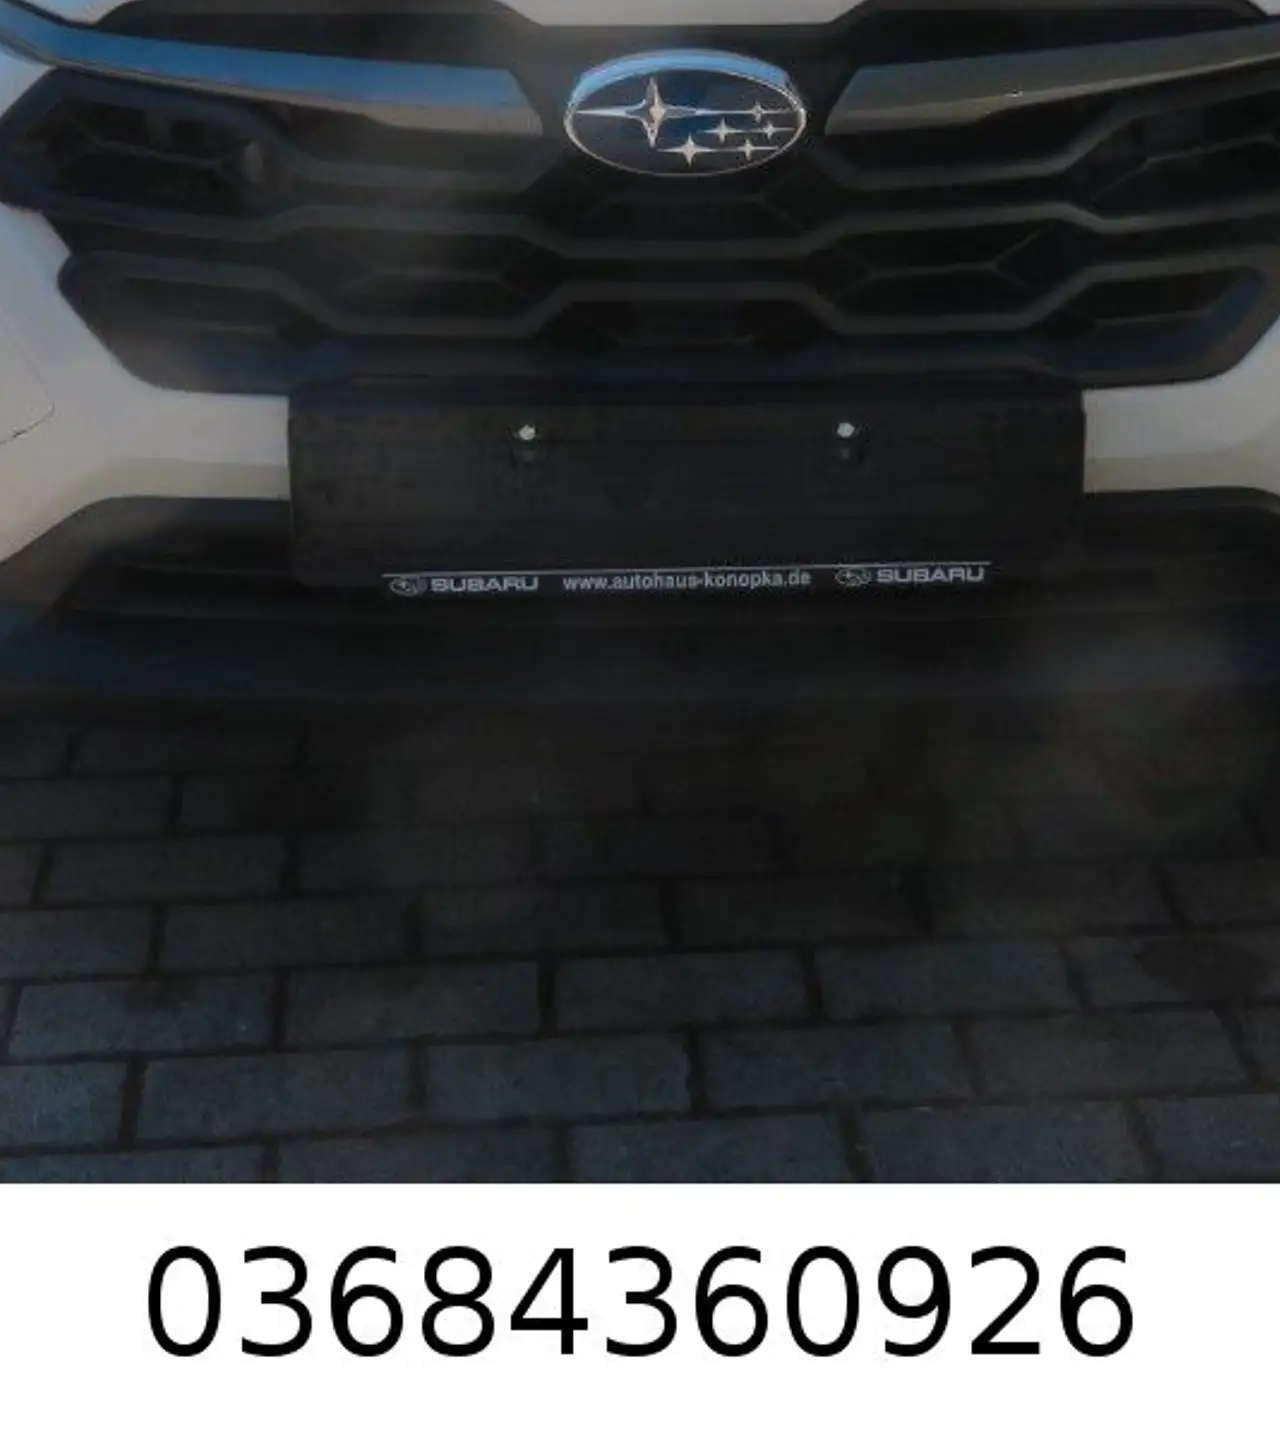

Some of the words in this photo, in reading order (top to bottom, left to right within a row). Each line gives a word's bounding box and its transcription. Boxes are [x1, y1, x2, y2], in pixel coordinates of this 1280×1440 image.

[431, 576, 540, 593] SUBARU
[563, 567, 812, 590] www.autohaus-konopka.de
[877, 565, 985, 584] SUBARU
